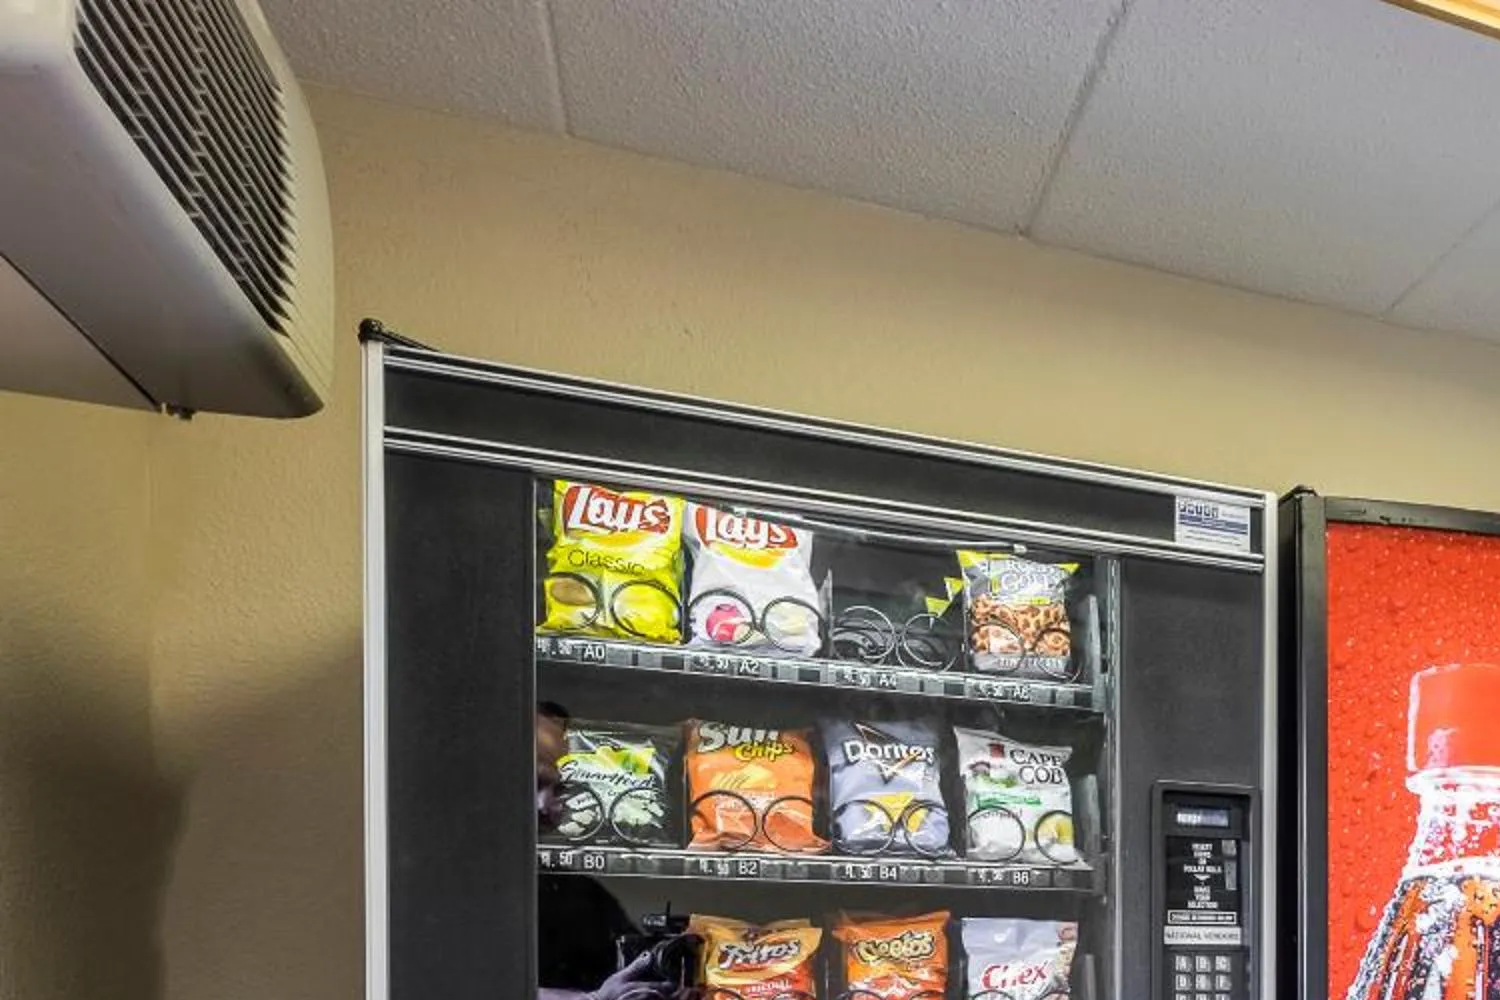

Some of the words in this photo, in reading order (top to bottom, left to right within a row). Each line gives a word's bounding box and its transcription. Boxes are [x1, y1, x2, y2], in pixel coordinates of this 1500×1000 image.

[567, 549, 645, 576] Classic
[583, 646, 605, 660] A0
[738, 661, 760, 674] A2
[734, 741, 794, 762] Chips
[843, 739, 935, 765] Doritos
[583, 855, 606, 871] B0
[737, 860, 759, 876] B2
[878, 865, 898, 881] B4
[716, 939, 803, 970] Fritos
[856, 930, 937, 966] Cheetos
[980, 959, 1051, 991] Chex
